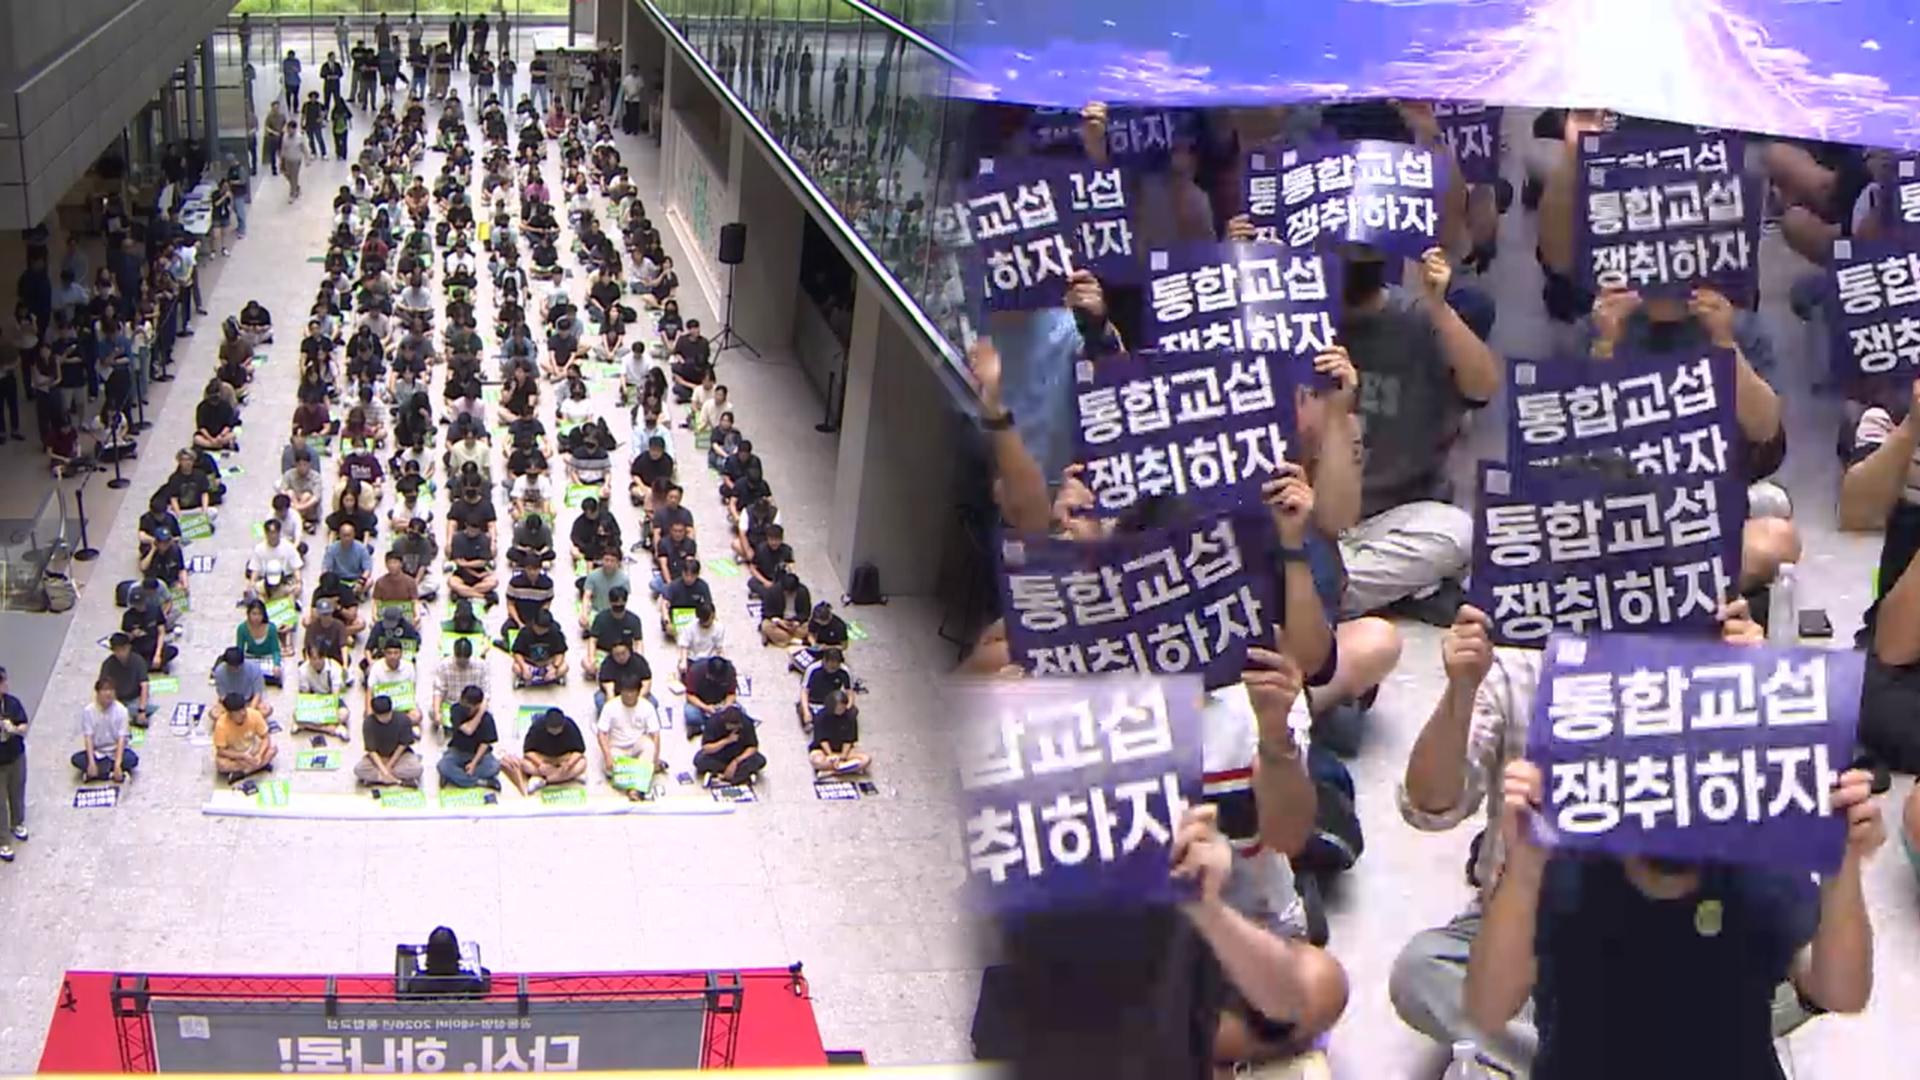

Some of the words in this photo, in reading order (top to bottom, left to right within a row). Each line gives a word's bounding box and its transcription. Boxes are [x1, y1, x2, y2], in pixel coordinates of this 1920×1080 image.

[1281, 149, 1434, 205] 통합교섭
[1588, 175, 1744, 235] 통합교섭
[1286, 193, 1438, 247] 쟁취하자
[1592, 229, 1751, 289] 쟁취하자
[1151, 255, 1328, 322] 통합교섭
[1077, 360, 1277, 445] 통합교섭
[1517, 358, 1718, 444] 통합교섭
[1087, 423, 1288, 512] 쟁취하자
[1485, 480, 1722, 568] 통합교섭
[1009, 519, 1243, 631] 통합교섭
[1492, 555, 1731, 640] 쟁취하자
[1547, 656, 1830, 742] 통합교섭
[1551, 743, 1841, 834] 쟁취하자
